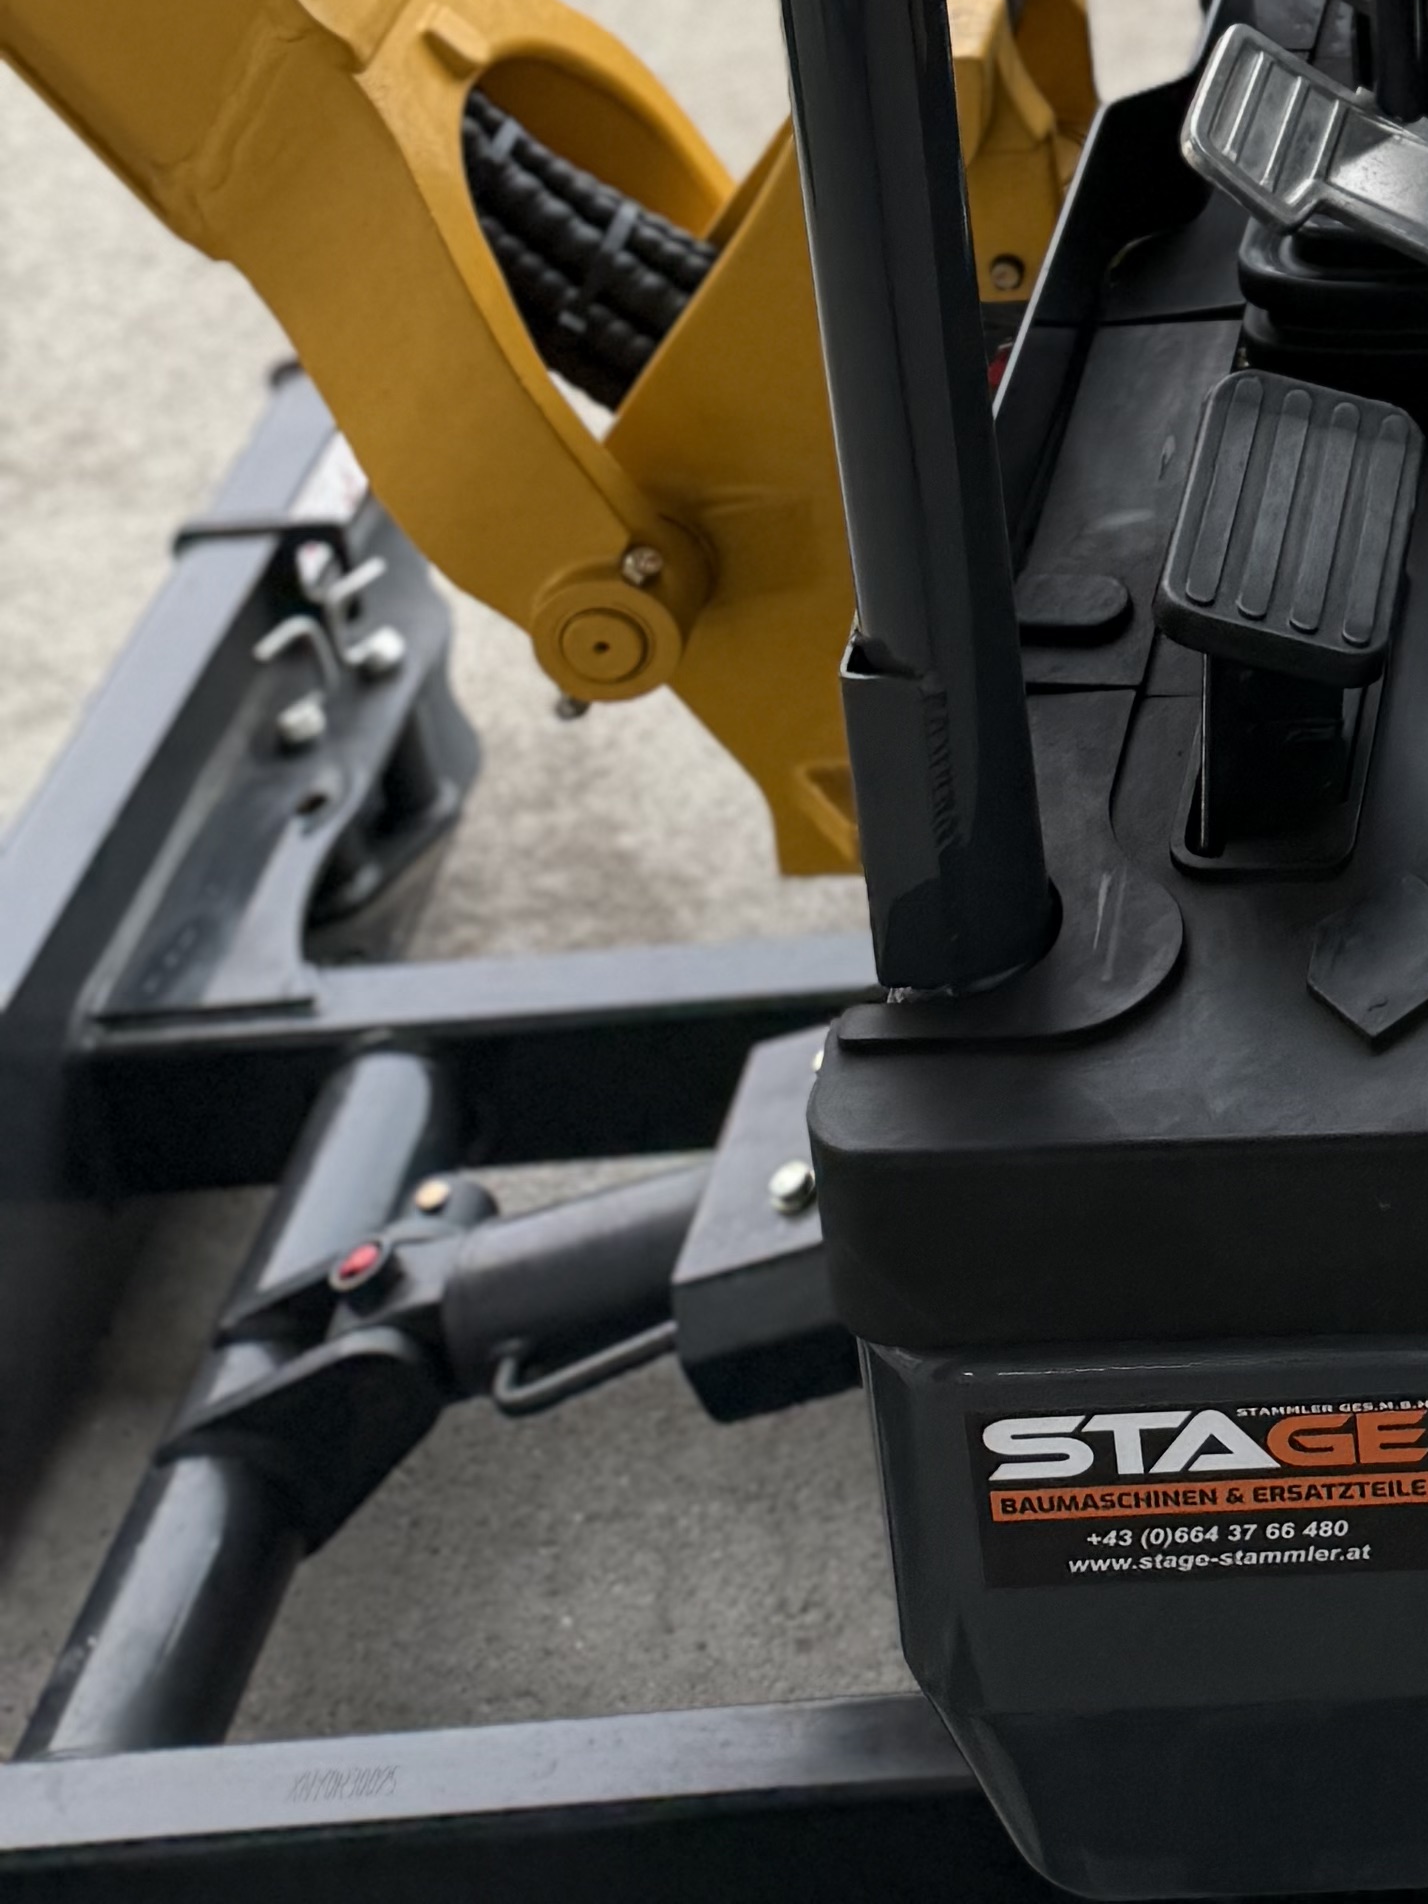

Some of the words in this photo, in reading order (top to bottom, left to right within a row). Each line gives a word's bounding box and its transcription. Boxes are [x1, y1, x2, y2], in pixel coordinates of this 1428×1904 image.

[1235, 1403, 1334, 1418] STAMMLER
[1000, 1488, 1218, 1516] BAUMASCHINEN
[1225, 1486, 1244, 1505] &
[1252, 1478, 1428, 1504] ERSATZTEILE
[1086, 1528, 1133, 1547] +43
[1140, 1524, 1220, 1550] (0)664
[1227, 1522, 1258, 1542] 37
[1265, 1521, 1296, 1540] 66
[1301, 1518, 1350, 1538] 480
[1067, 1543, 1372, 1573] www.stage-stammler.at
